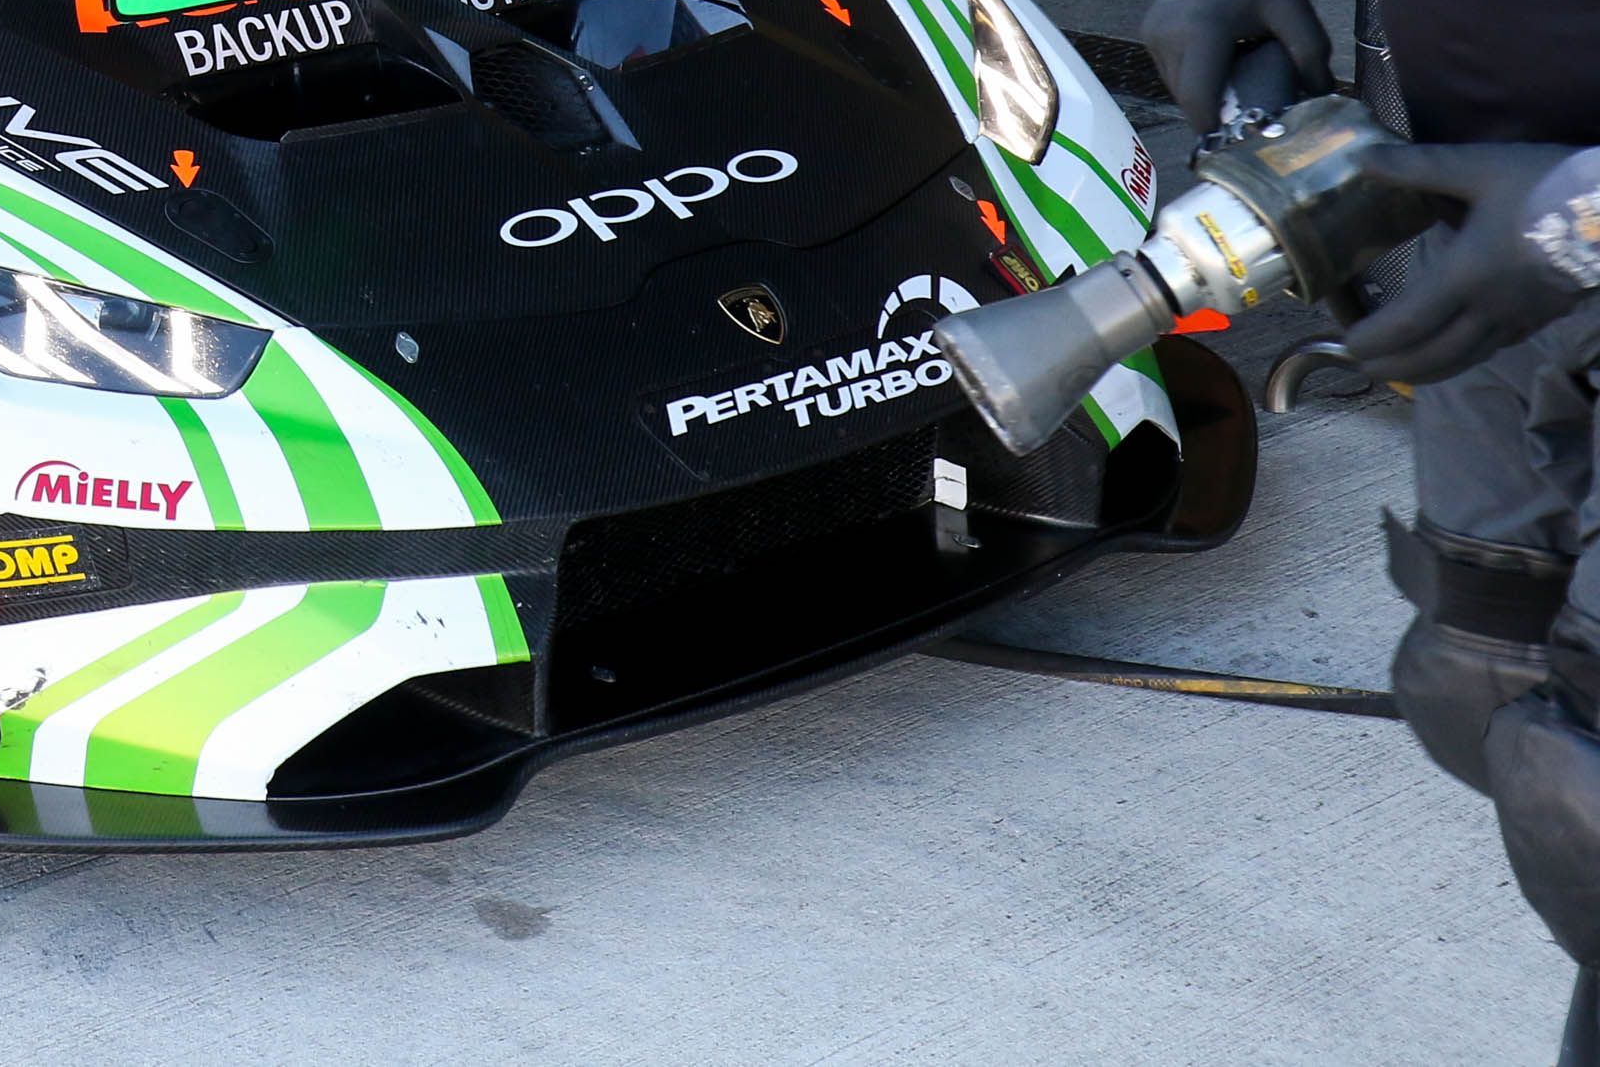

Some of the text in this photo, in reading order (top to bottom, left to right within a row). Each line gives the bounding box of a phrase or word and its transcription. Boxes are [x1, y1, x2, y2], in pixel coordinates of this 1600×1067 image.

[174, 0, 352, 76] BACKUP
[501, 149, 798, 248] oppo
[666, 330, 942, 437] PERTAMAX
[784, 359, 953, 427] TURBO
